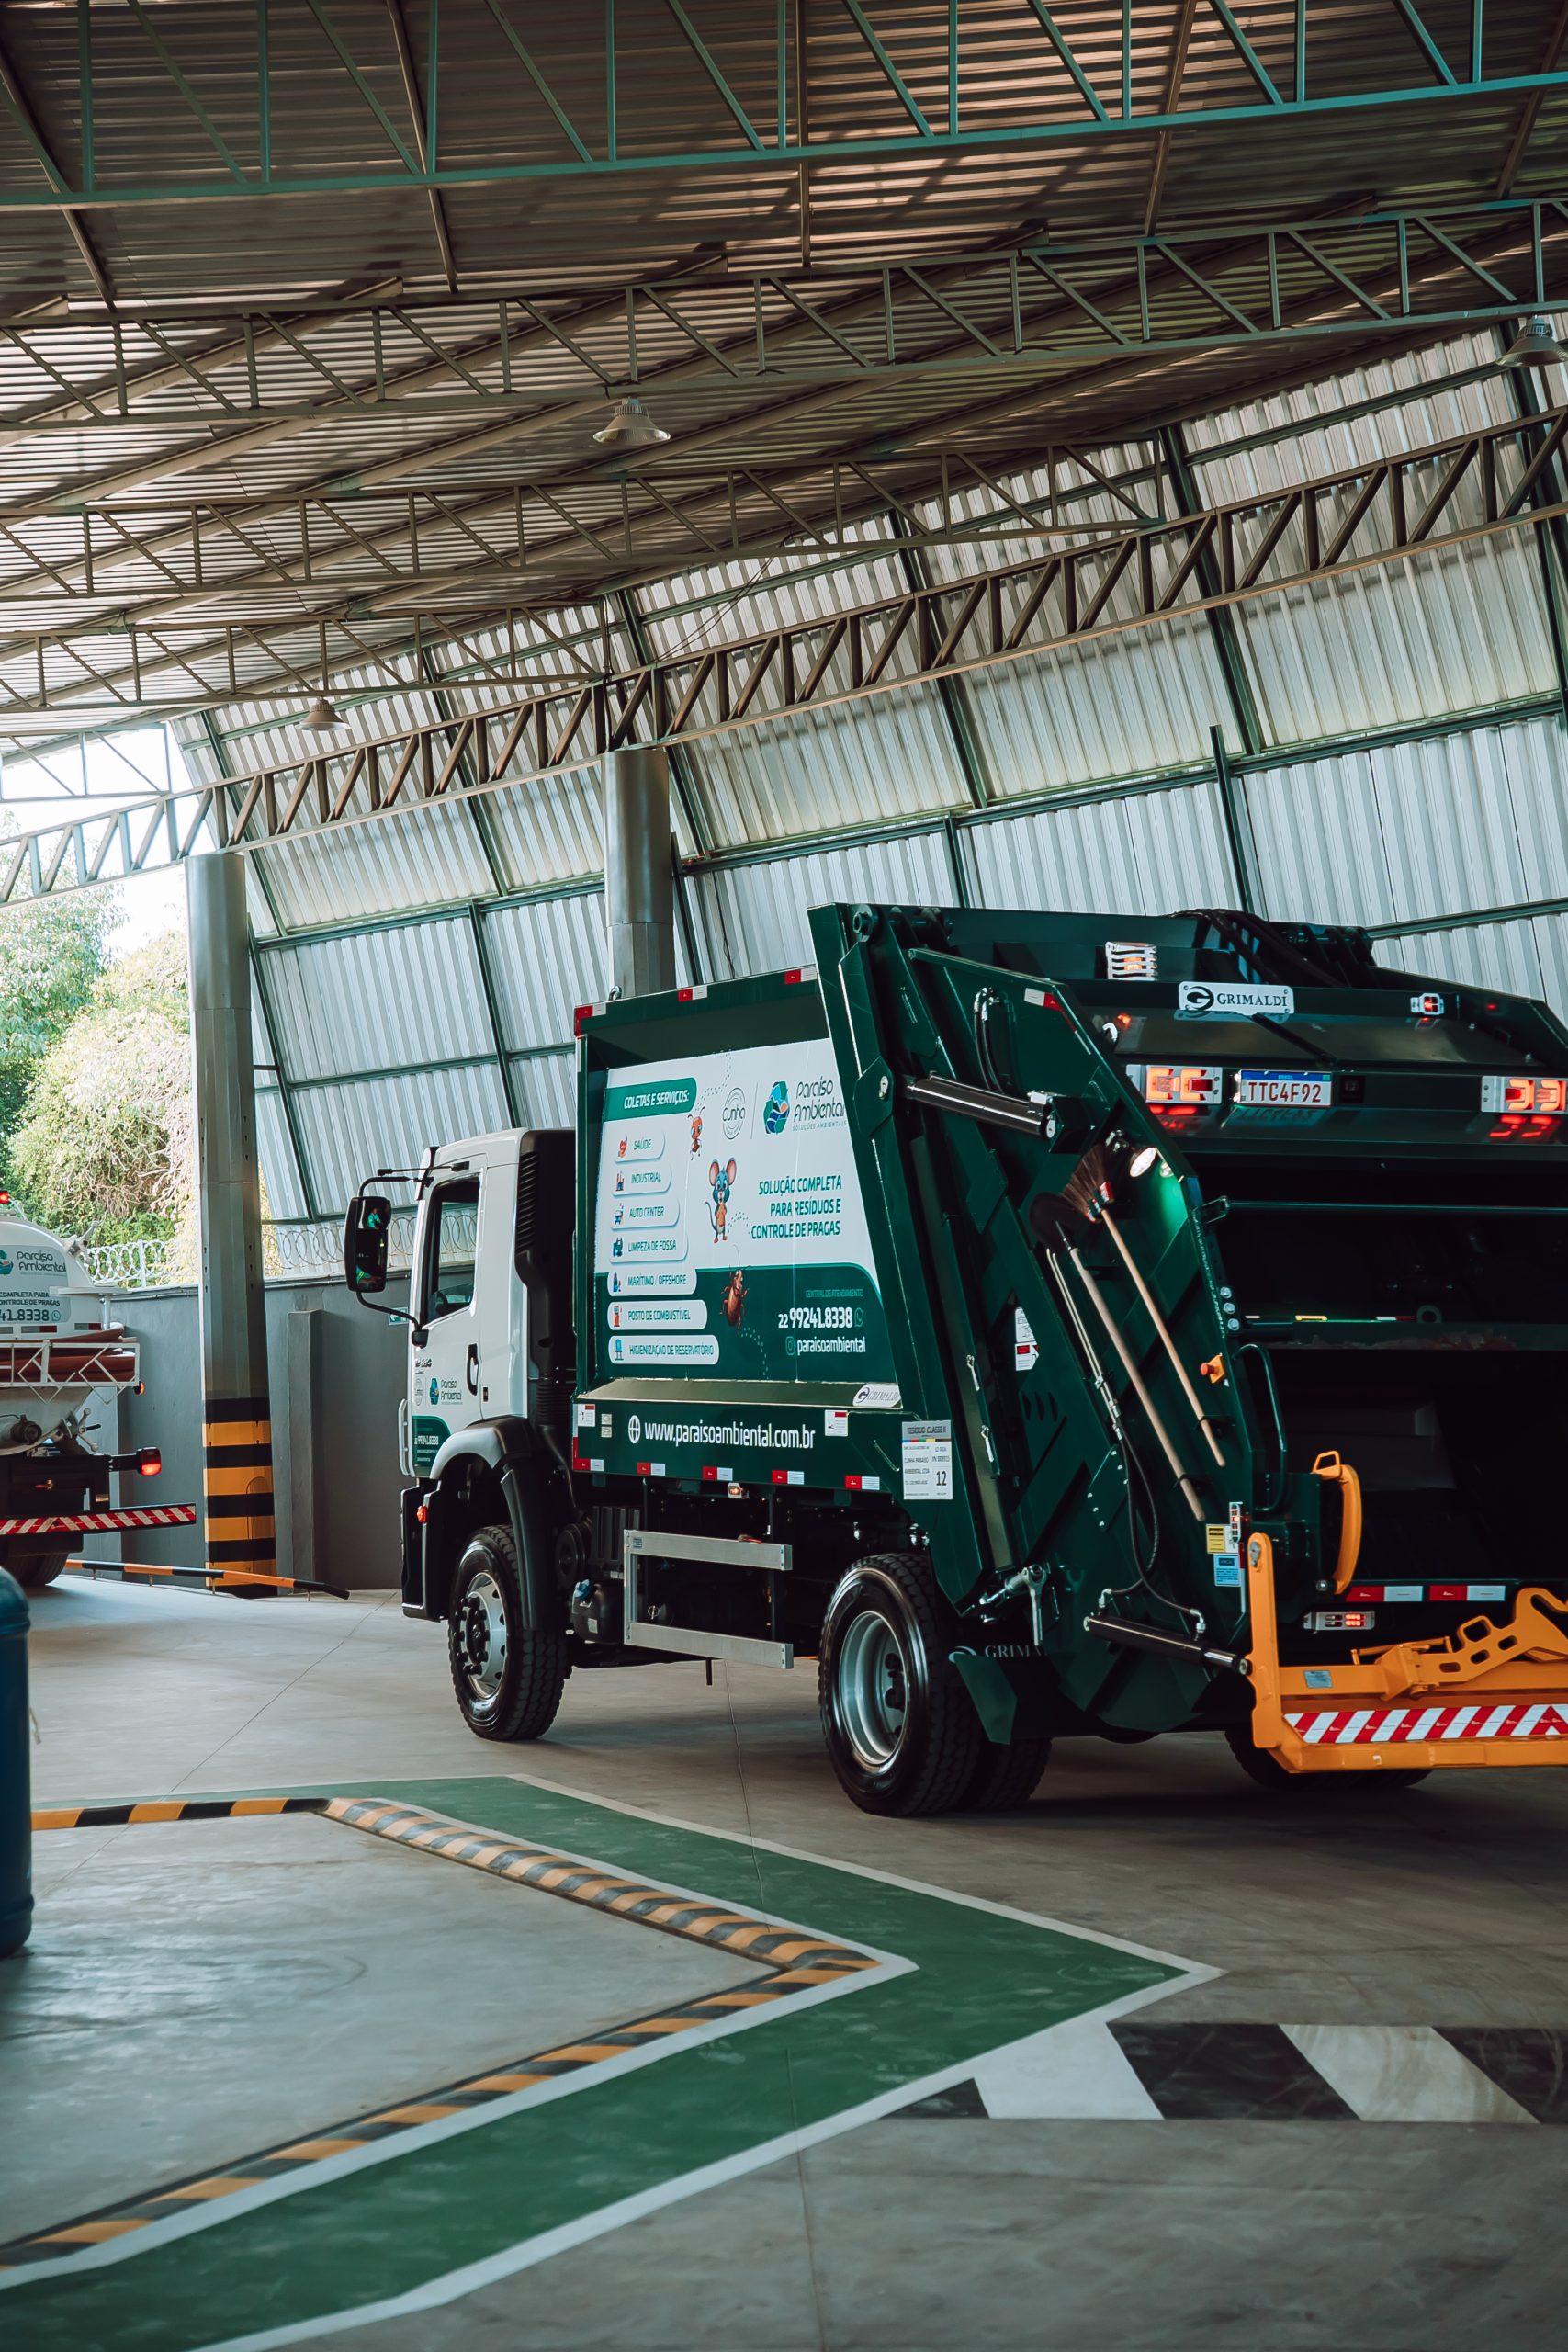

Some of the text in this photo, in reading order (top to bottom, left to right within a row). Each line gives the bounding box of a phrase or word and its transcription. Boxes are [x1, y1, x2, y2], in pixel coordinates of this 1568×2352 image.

[1216, 993, 1287, 1007] GRIMALDI
[624, 1090, 690, 1109] COLETAS E SERVIÇOS:
[1248, 1082, 1322, 1102] TTC4F92
[631, 1171, 661, 1184] INDUSTRIAL
[759, 1175, 842, 1196] SOLUÇÃO COMPLETA
[629, 1206, 664, 1218] AUTO CENTER
[770, 1196, 841, 1216] PARA RESÍDUOS E
[751, 1221, 840, 1239] CONTROLE DE PRAGAS
[628, 1239, 677, 1252] LIMPEZA DE FOSSA
[627, 1273, 654, 1286] MARÍTIMO
[659, 1274, 687, 1285] OFFSHORE
[628, 1310, 645, 1321] POSTO
[646, 1310, 653, 1320] DE
[778, 1306, 853, 1329] 22 99241.8338
[667, 1345, 674, 1355] DE
[796, 1336, 866, 1356] paraisoambiental
[645, 1419, 816, 1449] www.paraisoambiental.com.br
[936, 1471, 947, 1486] 12
